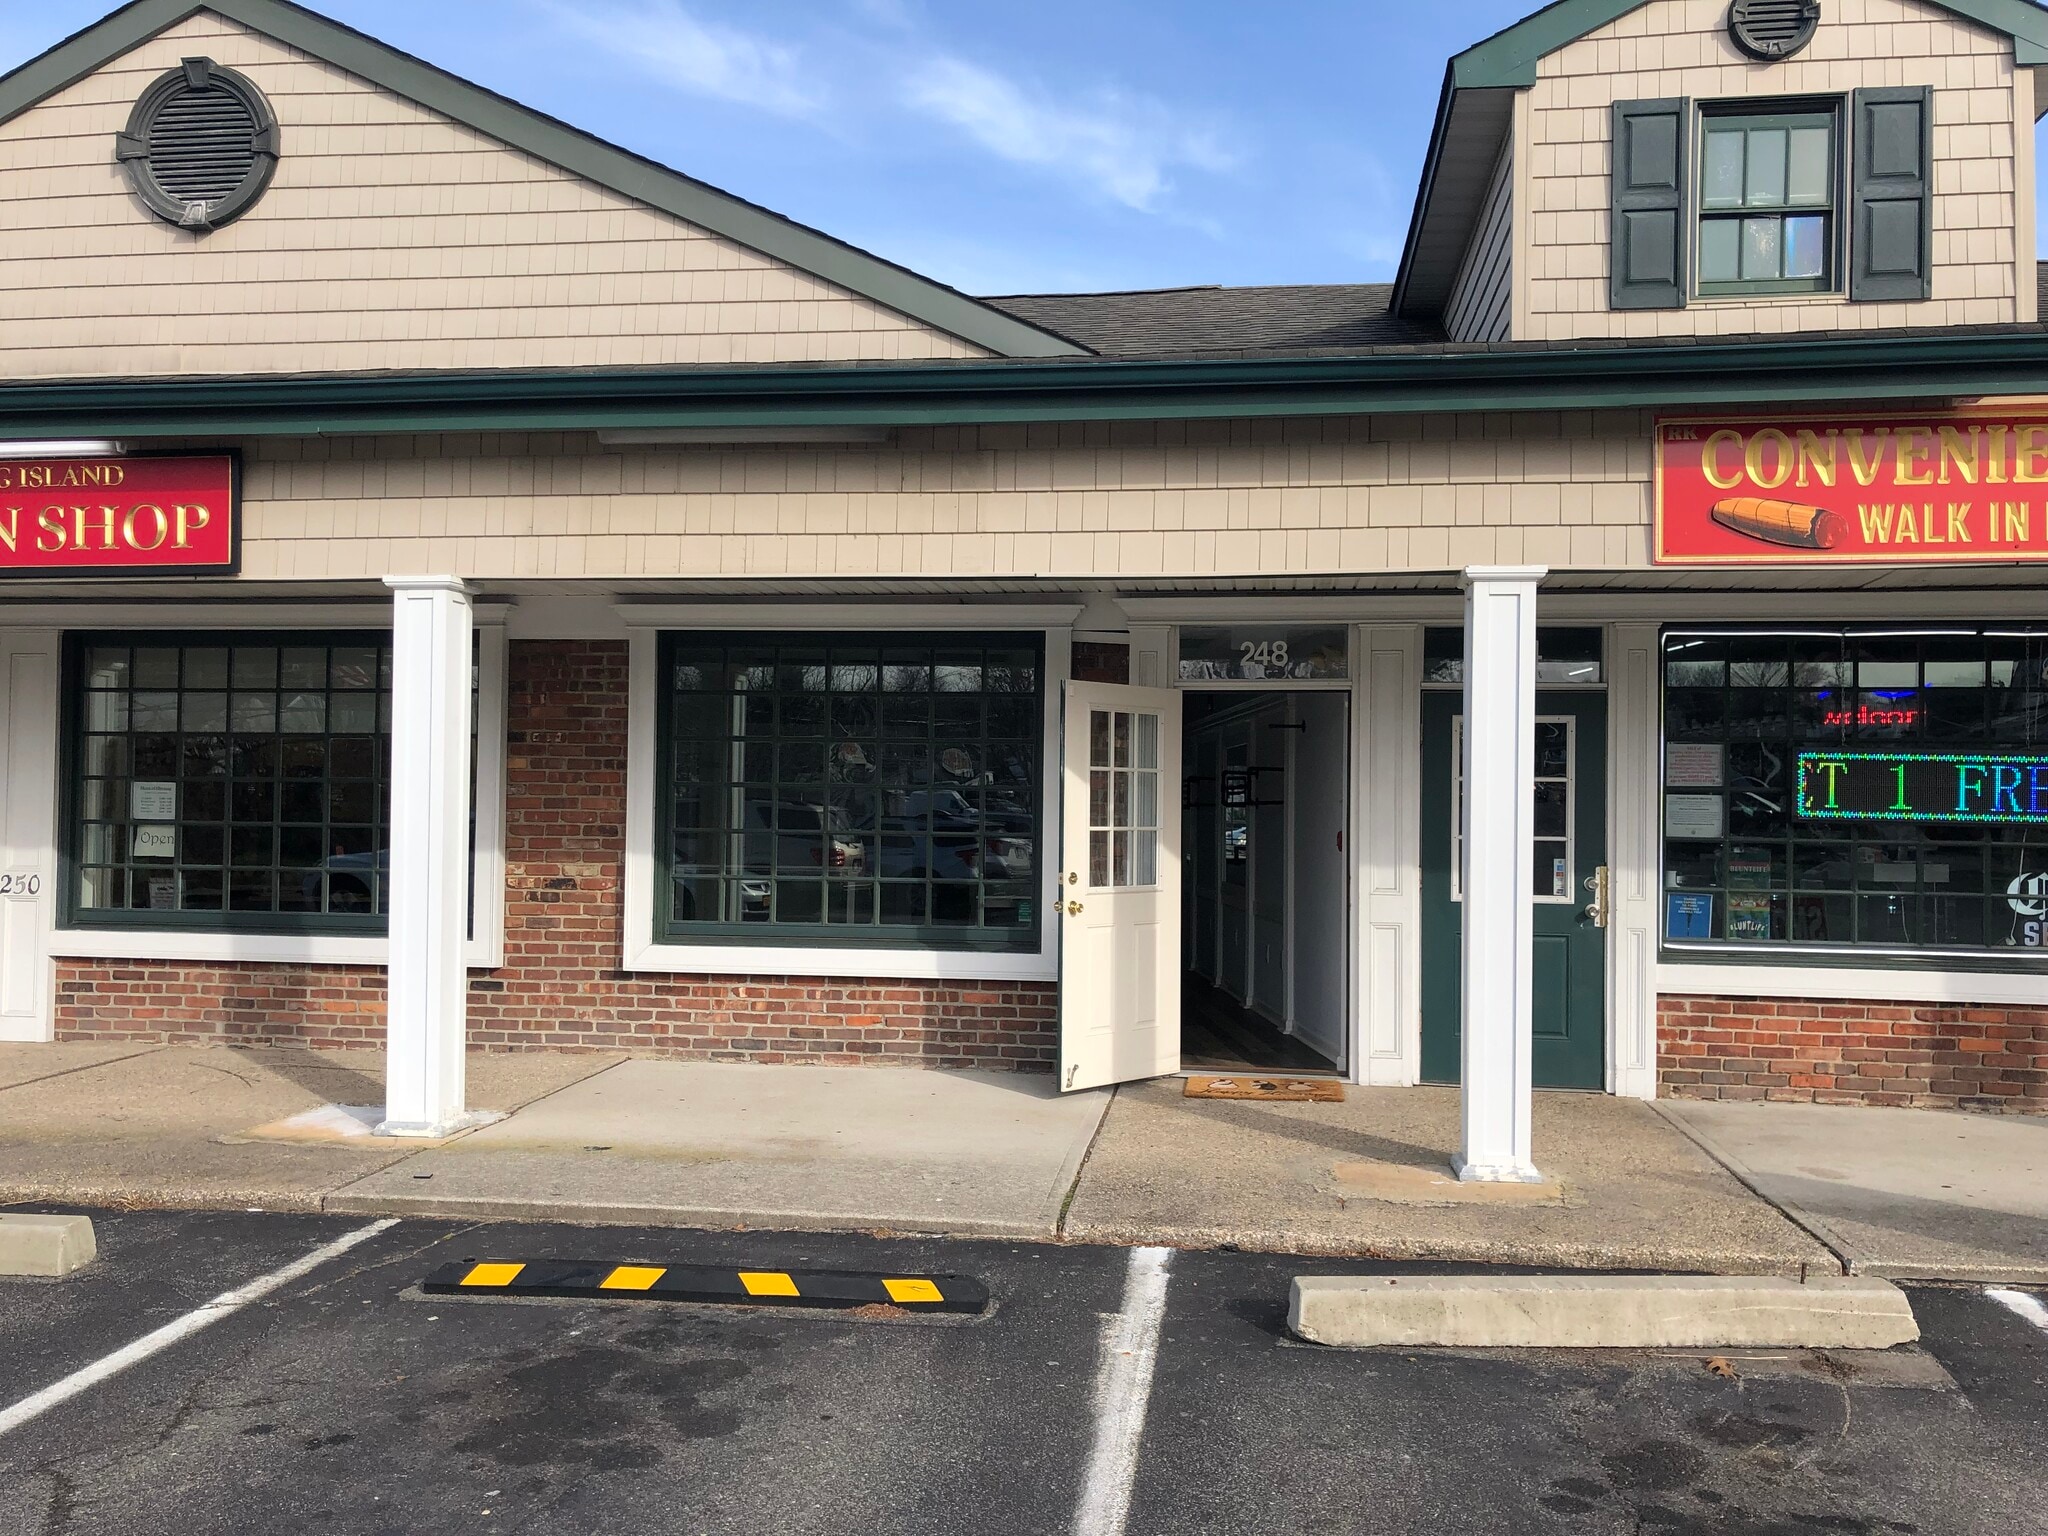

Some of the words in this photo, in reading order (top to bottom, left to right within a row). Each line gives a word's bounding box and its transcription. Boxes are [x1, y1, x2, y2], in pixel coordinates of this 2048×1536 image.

[1668, 427, 1698, 441] RK
[18, 464, 125, 488] ISLAND
[37, 503, 210, 552] SHOP
[1857, 502, 1973, 543] WALK
[1990, 501, 2030, 542] IN
[1240, 640, 1289, 667] 248
[1889, 763, 1912, 810] 1
[141, 831, 175, 846] Open
[0, 874, 40, 895] 250
